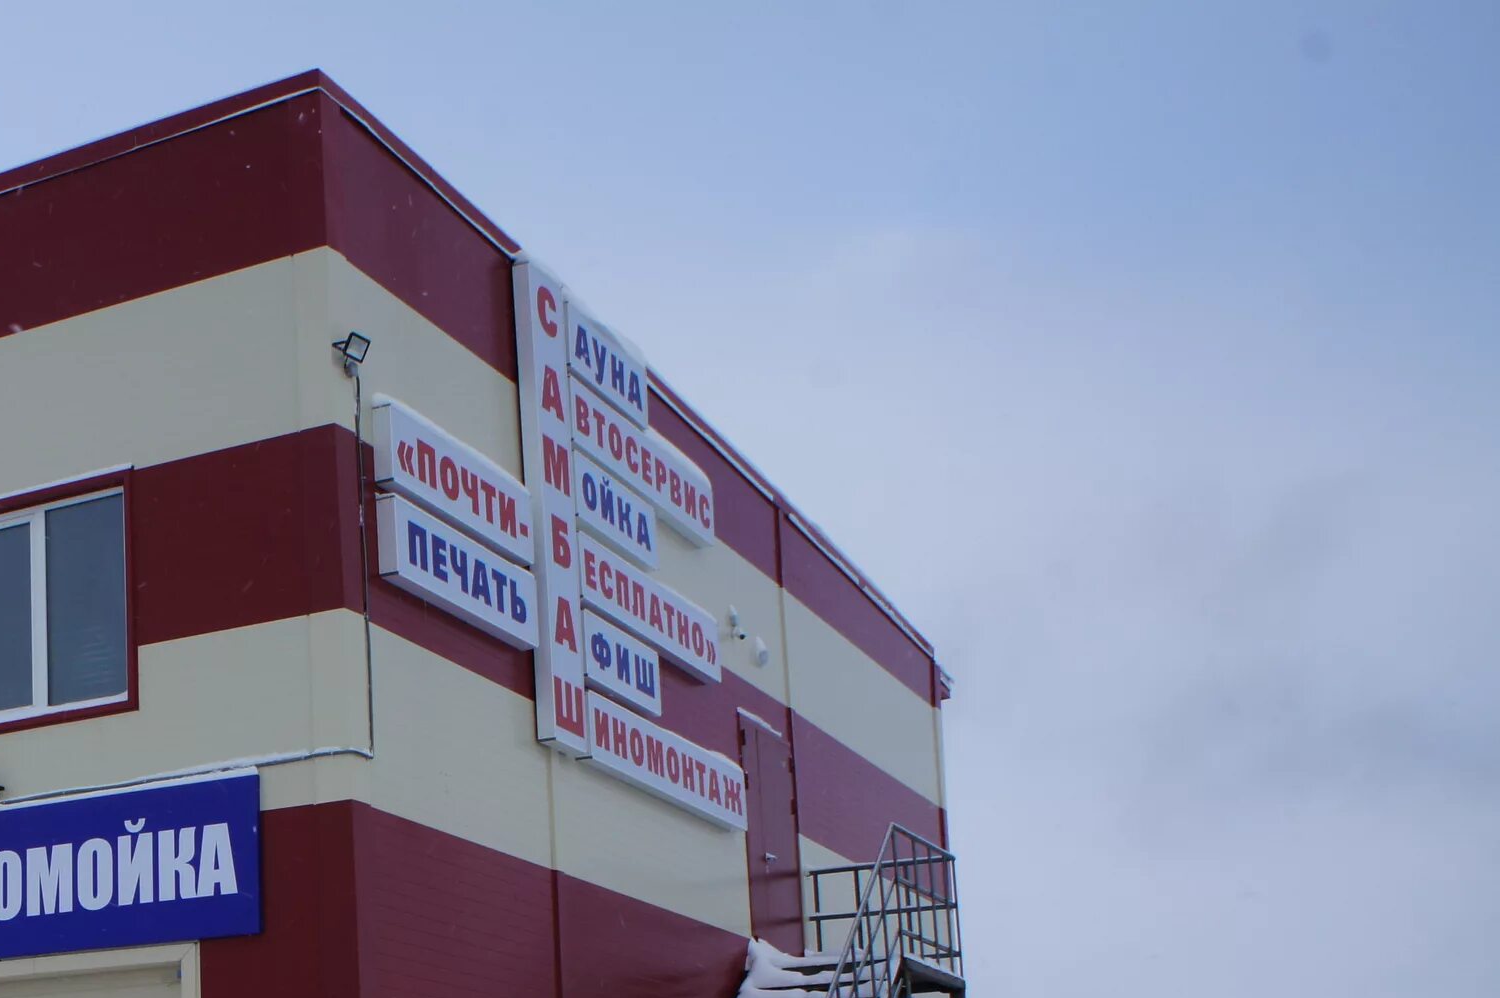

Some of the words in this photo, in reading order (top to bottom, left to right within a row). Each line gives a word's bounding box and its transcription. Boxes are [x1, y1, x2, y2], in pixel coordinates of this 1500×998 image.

[574, 323, 644, 412] АУНА
[536, 285, 585, 739] САМБАШ
[574, 394, 712, 530] ВТОСЕРВИС
[582, 472, 653, 552] ОЙКА
[407, 520, 528, 625] ПЕЧАТЬ
[591, 631, 656, 699] ФИШ
[593, 706, 744, 817] ИНОМОНТАЖ
